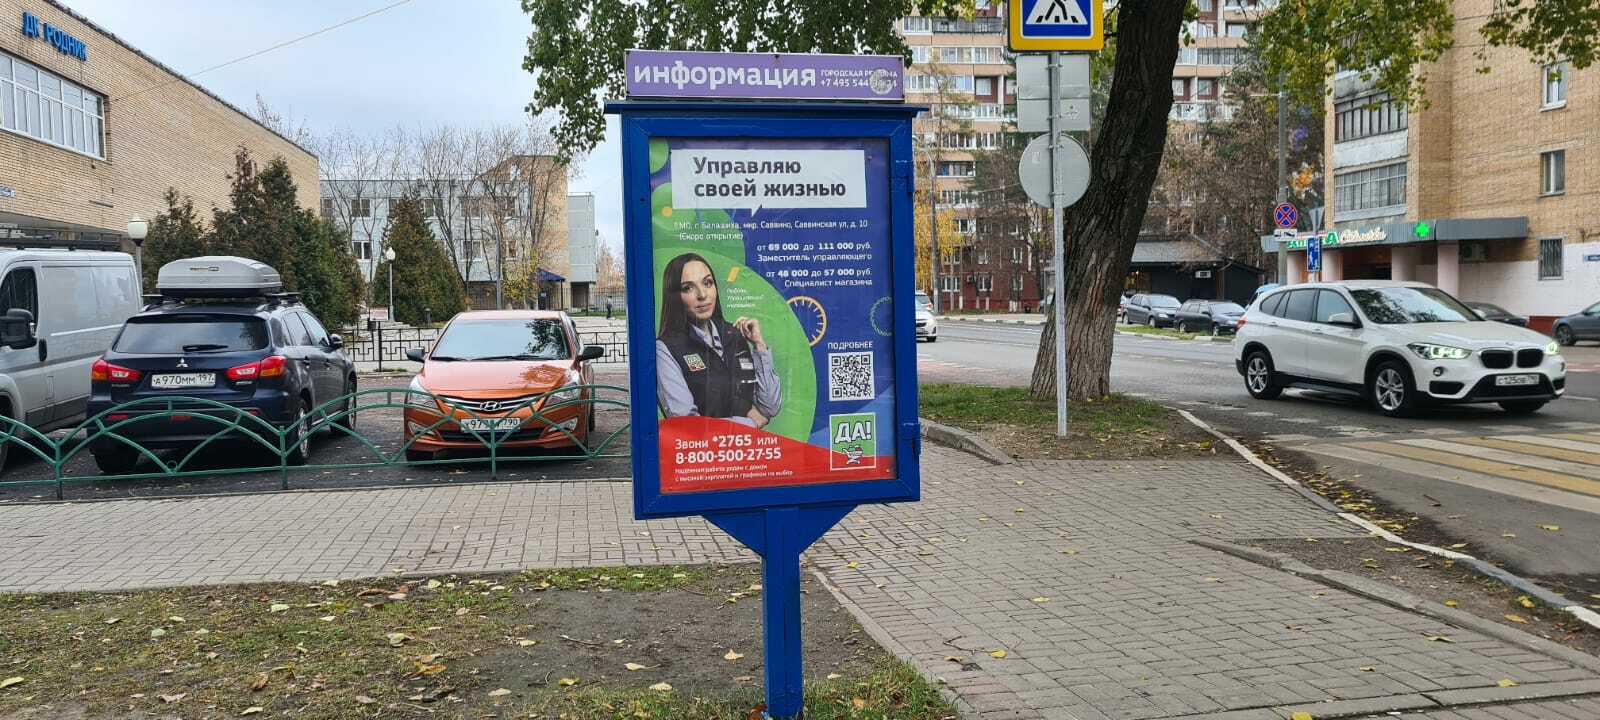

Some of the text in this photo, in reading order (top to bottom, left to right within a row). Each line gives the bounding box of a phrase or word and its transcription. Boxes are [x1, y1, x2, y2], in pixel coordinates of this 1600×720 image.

[22, 11, 87, 61] ДК РОДНИК
[634, 61, 816, 90] информация
[821, 69, 863, 77] ГОРОДСКАЯ
[821, 78, 831, 87] +7
[833, 79, 849, 87] 495
[693, 157, 801, 178] Управляю
[694, 179, 846, 197] своей жизнью
[860, 220, 868, 228] 10
[782, 243, 799, 251] 000
[856, 242, 872, 251] руб.
[758, 254, 872, 262] Заместитель управляющего
[811, 270, 822, 278] до
[785, 279, 872, 288] Специалист магазина
[828, 341, 873, 350] ПОДРОБНЕЕ
[834, 421, 872, 444] ДА!
[675, 439, 709, 450] Звони
[757, 437, 777, 445] или
[675, 447, 782, 464] 8-800-500-27-55
